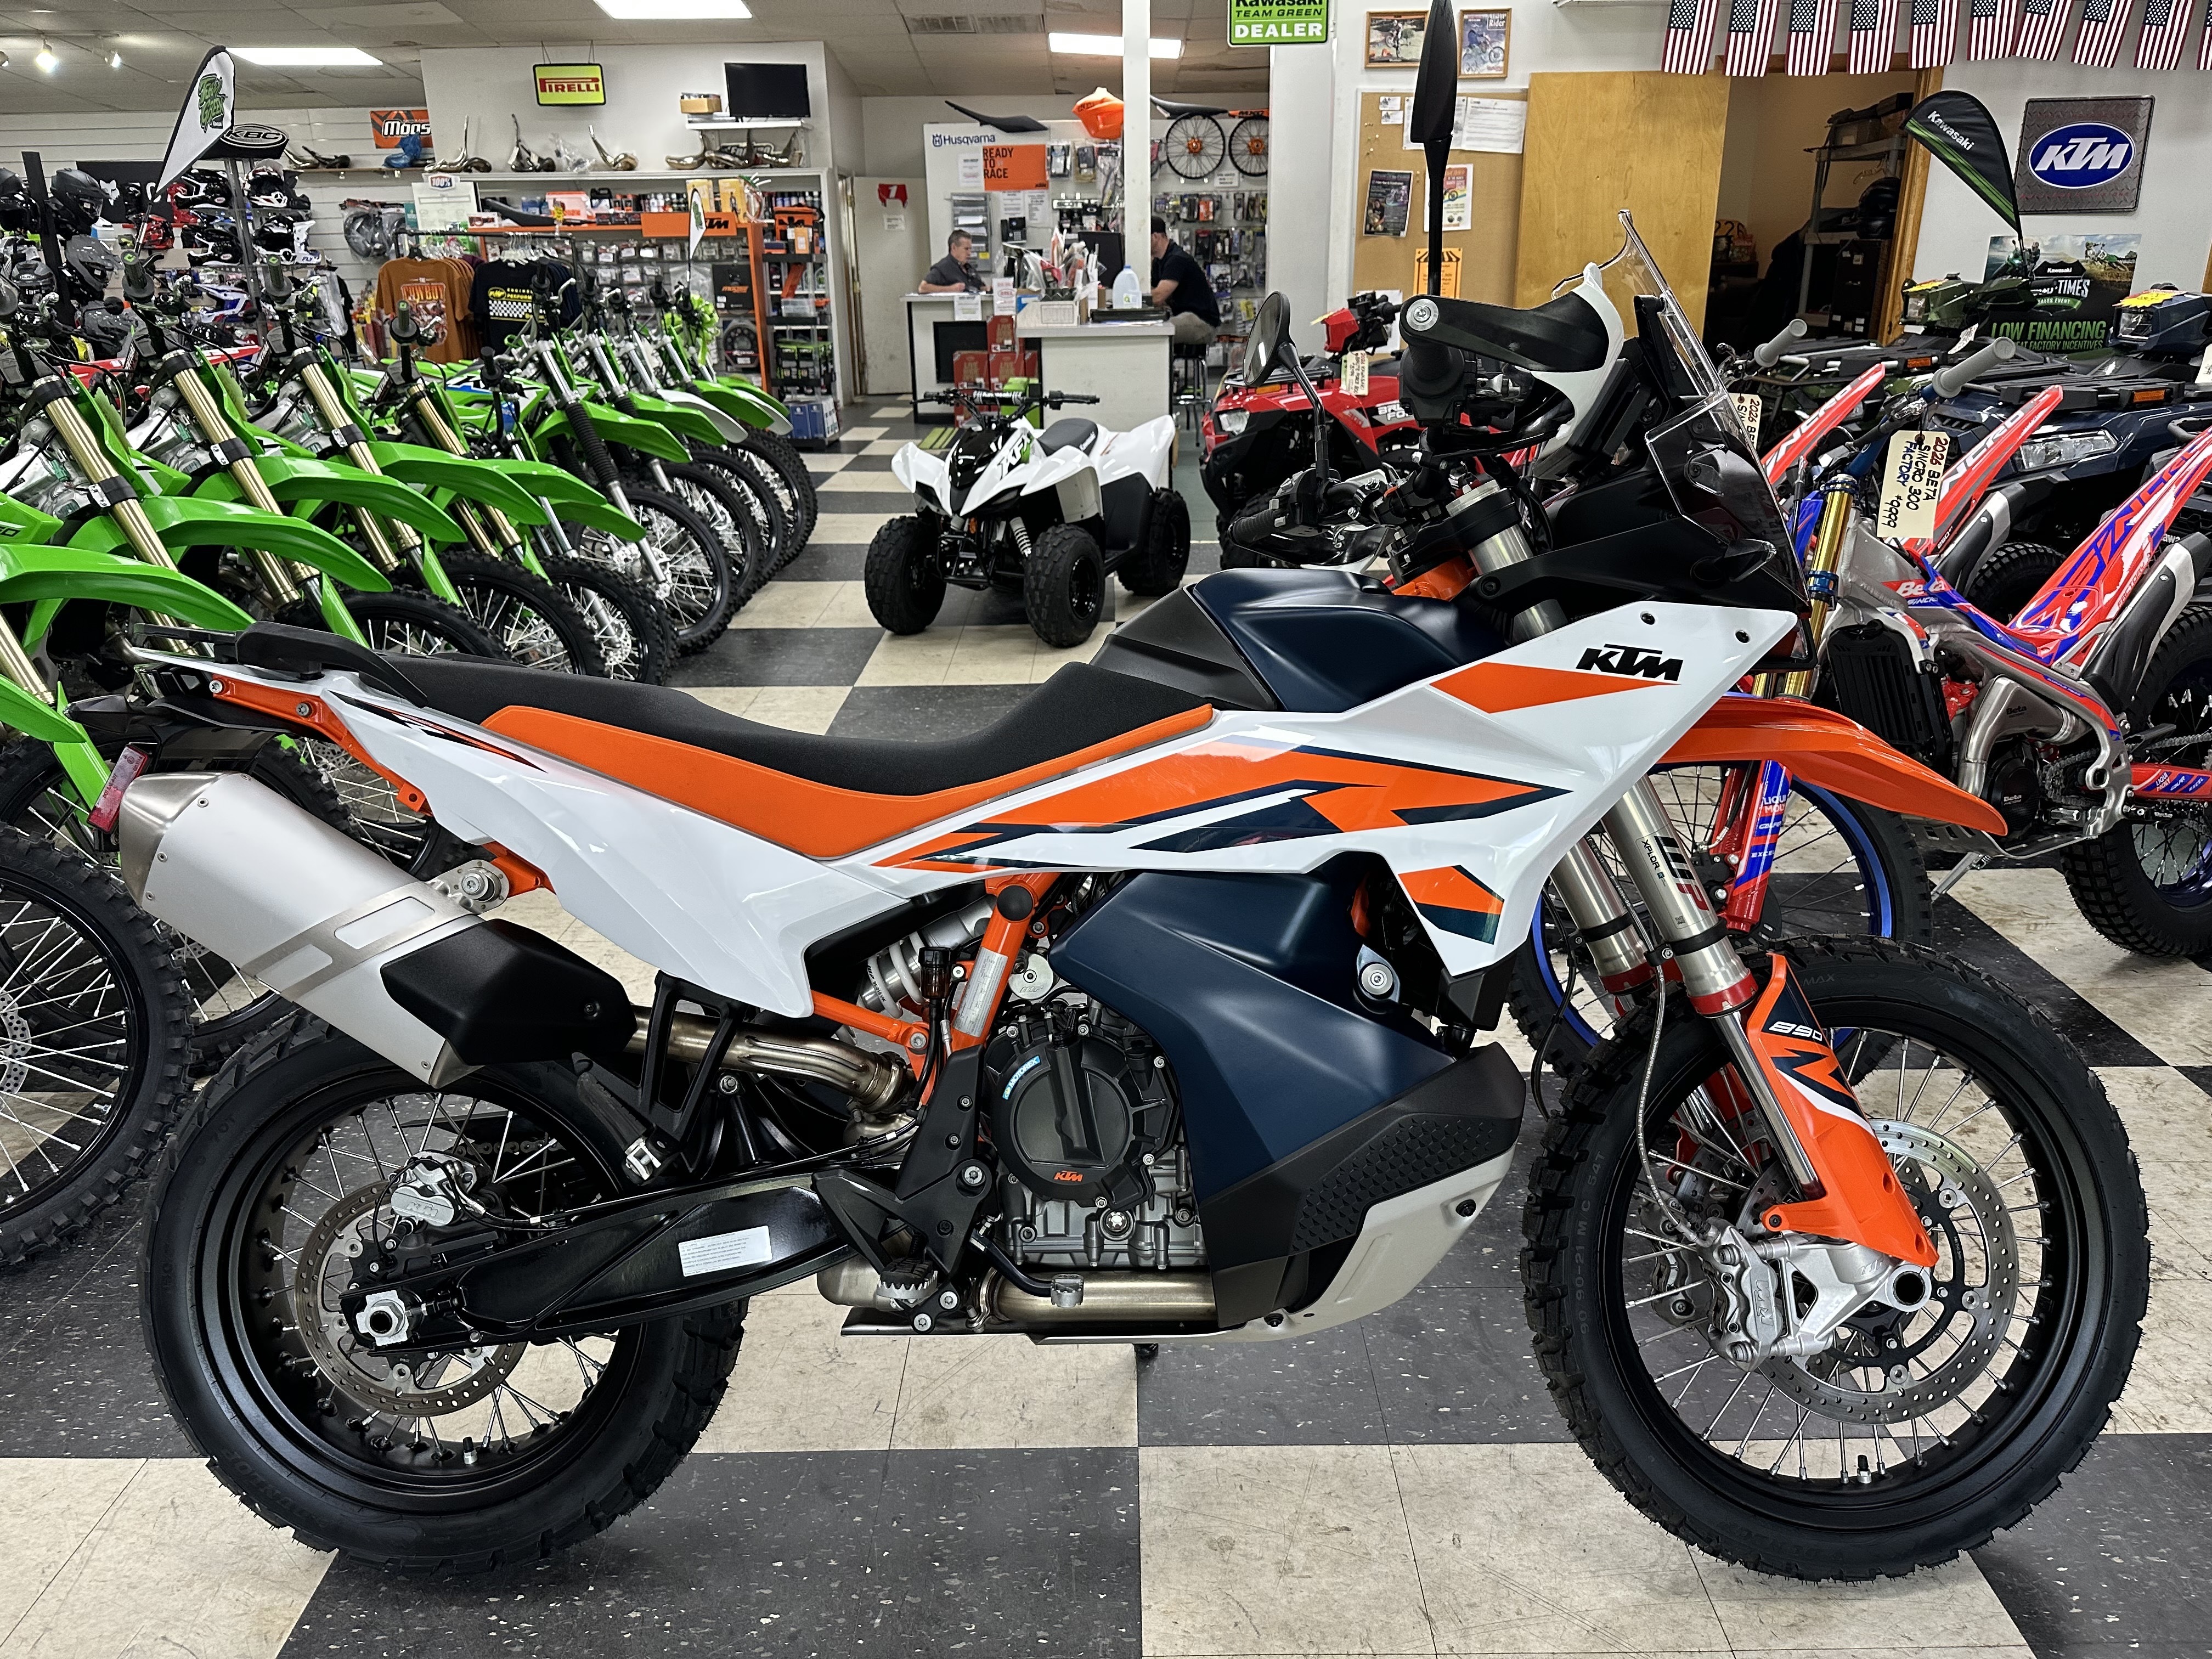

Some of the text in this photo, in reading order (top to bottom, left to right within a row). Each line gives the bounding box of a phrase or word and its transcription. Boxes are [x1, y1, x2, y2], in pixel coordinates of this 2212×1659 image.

[1235, 23, 1322, 38] DEALER
[539, 78, 599, 92] PIRELLI
[224, 129, 282, 139] KBC
[944, 134, 996, 145] Husqvarna
[1927, 111, 1975, 151] Kawasaki
[983, 148, 1014, 159] READY
[2034, 137, 2130, 171] KTM
[984, 159, 995, 168] TO
[431, 177, 451, 187] 100%
[984, 168, 1008, 179] RACE
[706, 218, 729, 229] TM
[2058, 279, 2090, 298] TIMES
[1991, 321, 2106, 340] LOW FINANCING
[2029, 340, 2062, 351] FACTORY
[2062, 340, 2103, 350] INCENTIVES
[1747, 398, 1760, 445] 2026 BE
[998, 436, 1031, 479] KFX
[1896, 441, 1917, 487] FACTORY
[1906, 445, 1931, 511] SINCRO 300
[1922, 437, 1948, 500] 2026 BETA
[1576, 644, 1684, 681] KTM
[2006, 706, 2027, 715] Beta
[1763, 795, 1786, 804] LIQUI
[1763, 804, 1785, 814] MOLY
[1641, 839, 1660, 870] XPLOR
[1654, 835, 1709, 911] WP
[1769, 1021, 1822, 1041] 890
[1009, 1057, 1039, 1087] MOTOREX
[1054, 1170, 1082, 1182] KTM
[1587, 1150, 1605, 1187] 54T
[1577, 1200, 1591, 1236] M/C
[1753, 1280, 1774, 1325] KTM
